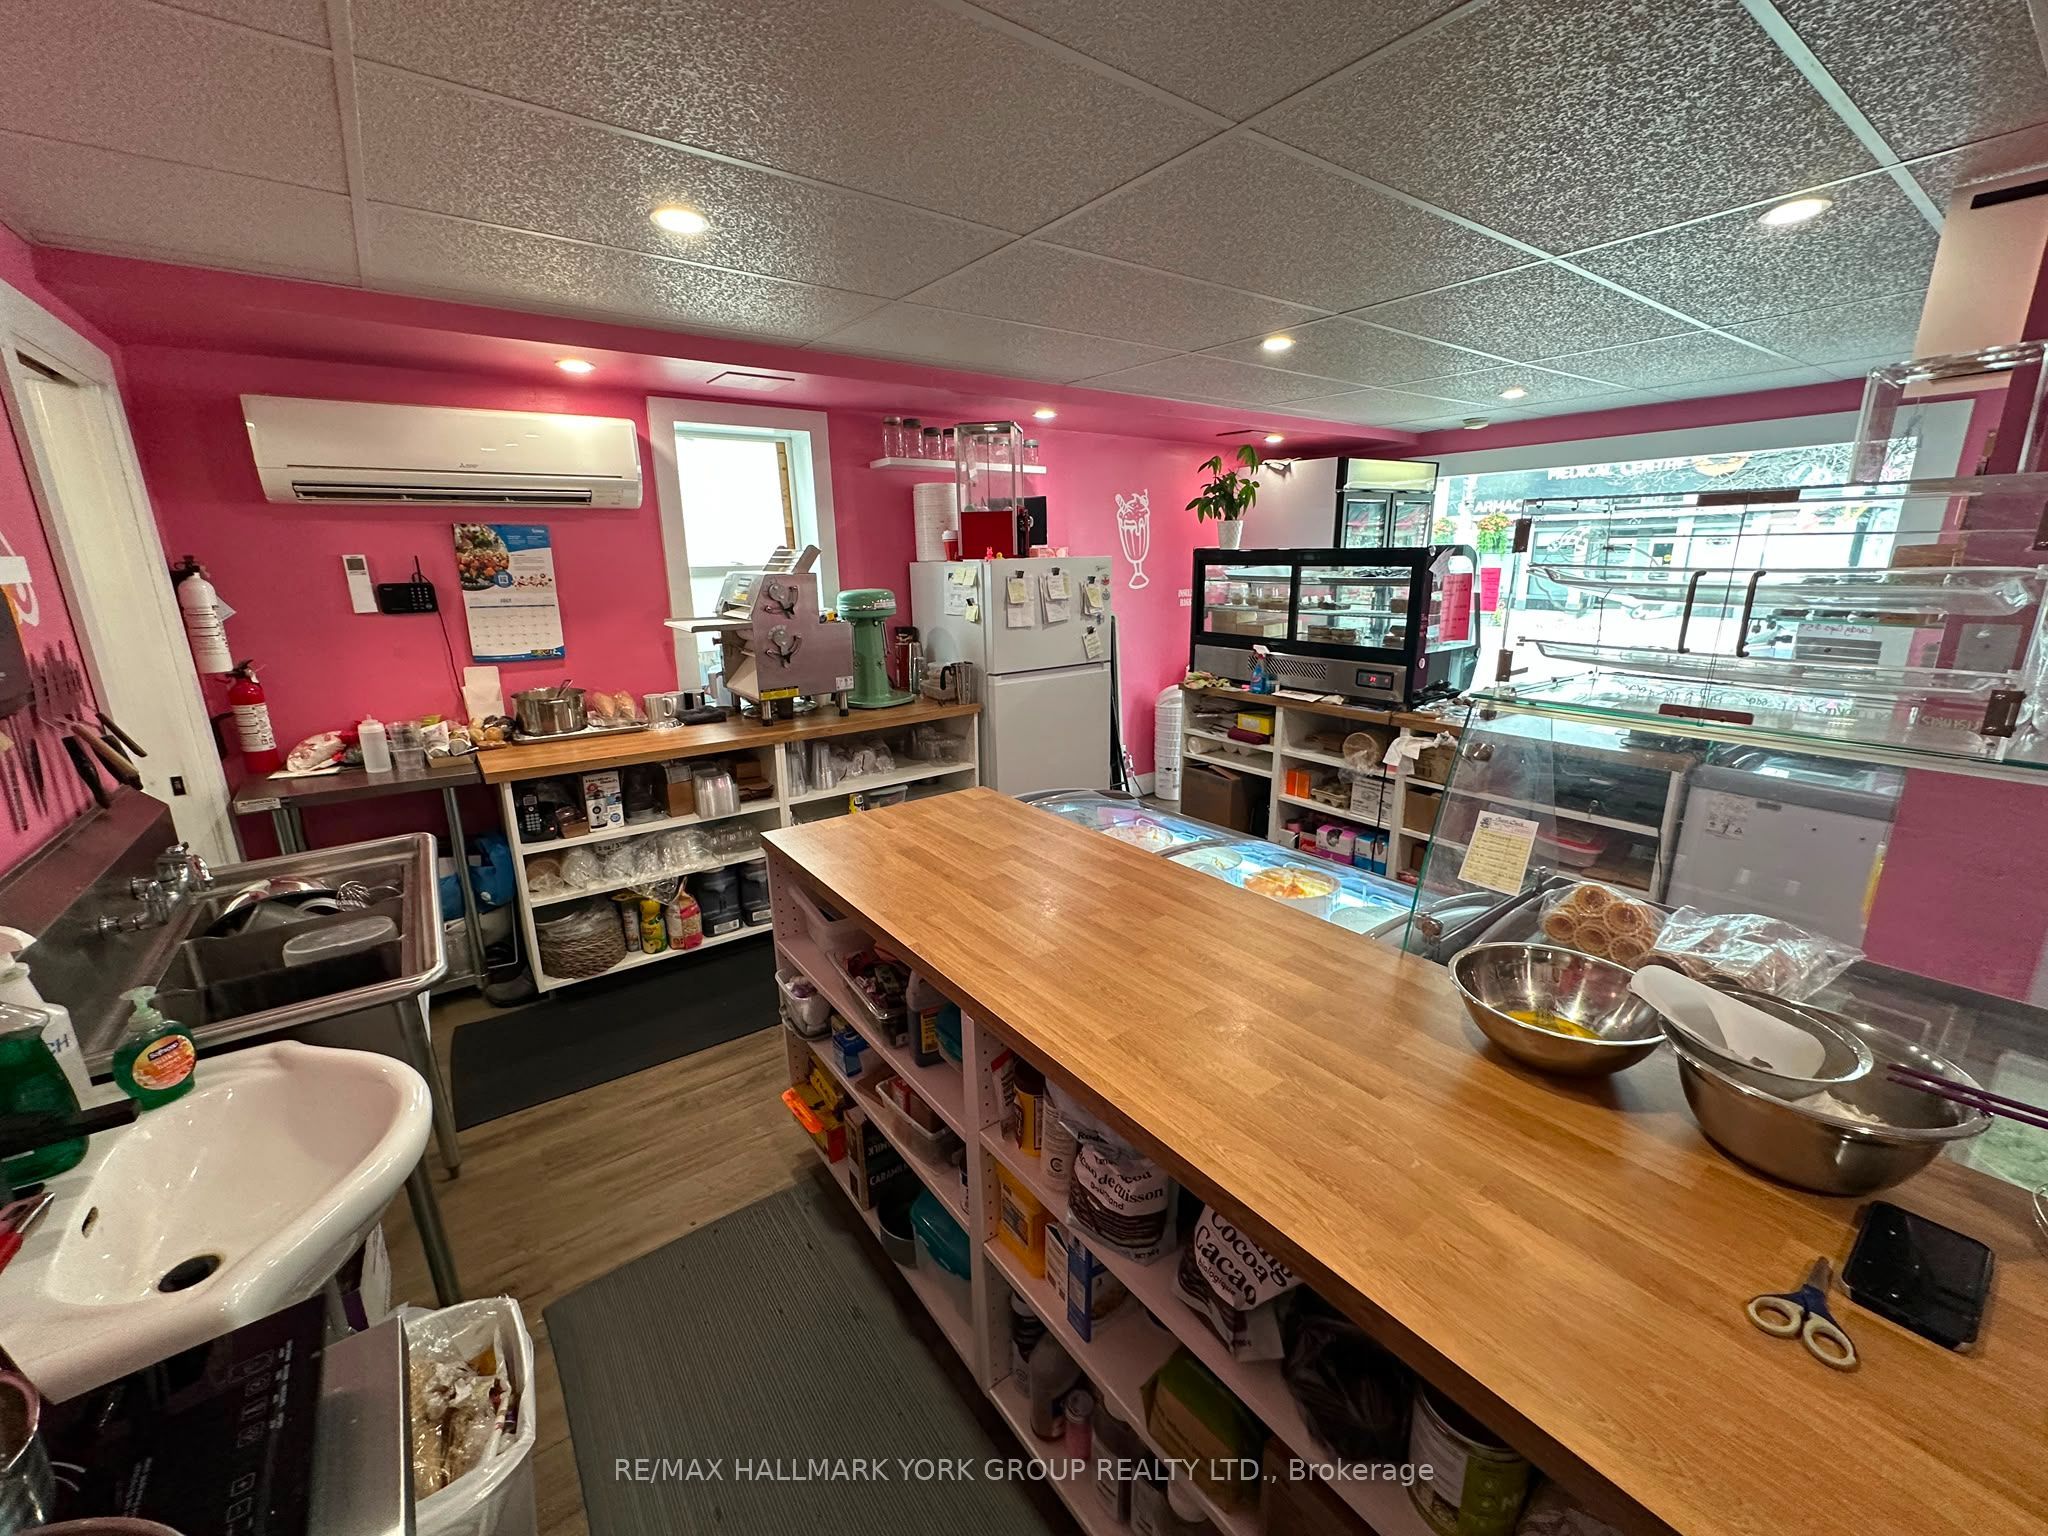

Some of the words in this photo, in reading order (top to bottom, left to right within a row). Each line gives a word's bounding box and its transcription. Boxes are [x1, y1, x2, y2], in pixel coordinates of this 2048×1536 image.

[1548, 465, 1612, 480] MEDICAL
[1098, 1174, 1115, 1189] de
[1114, 1184, 1163, 1203] cuisson
[1196, 1225, 1257, 1305] Cacao
[1211, 1211, 1268, 1285] Cocoa
